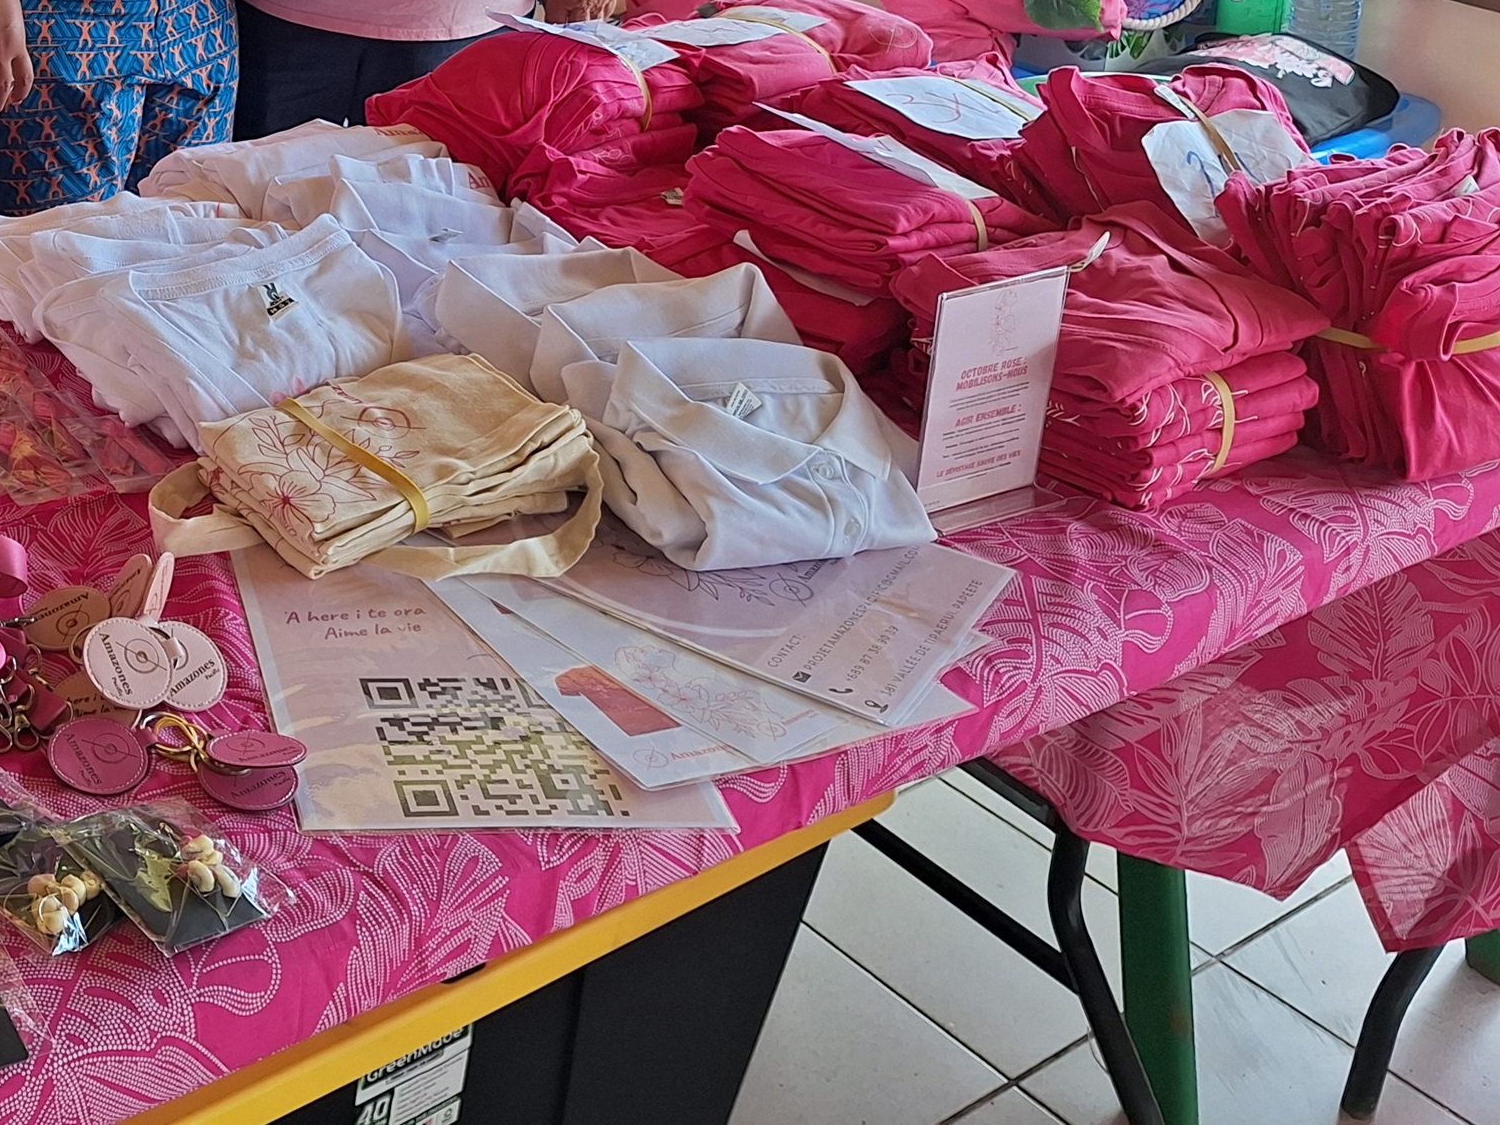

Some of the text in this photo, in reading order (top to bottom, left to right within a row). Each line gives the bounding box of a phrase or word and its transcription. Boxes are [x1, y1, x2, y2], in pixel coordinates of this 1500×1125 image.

[307, 611, 349, 622] here
[356, 610, 361, 620] i
[368, 608, 387, 619] te
[393, 607, 427, 617] ora
[324, 623, 422, 641] Aime la vie
[916, 644, 931, 657] DE
[951, 579, 984, 611] PAPEETE
[99, 633, 133, 695] Amazones
[169, 658, 216, 697] Amazones
[63, 734, 103, 785] Amazones
